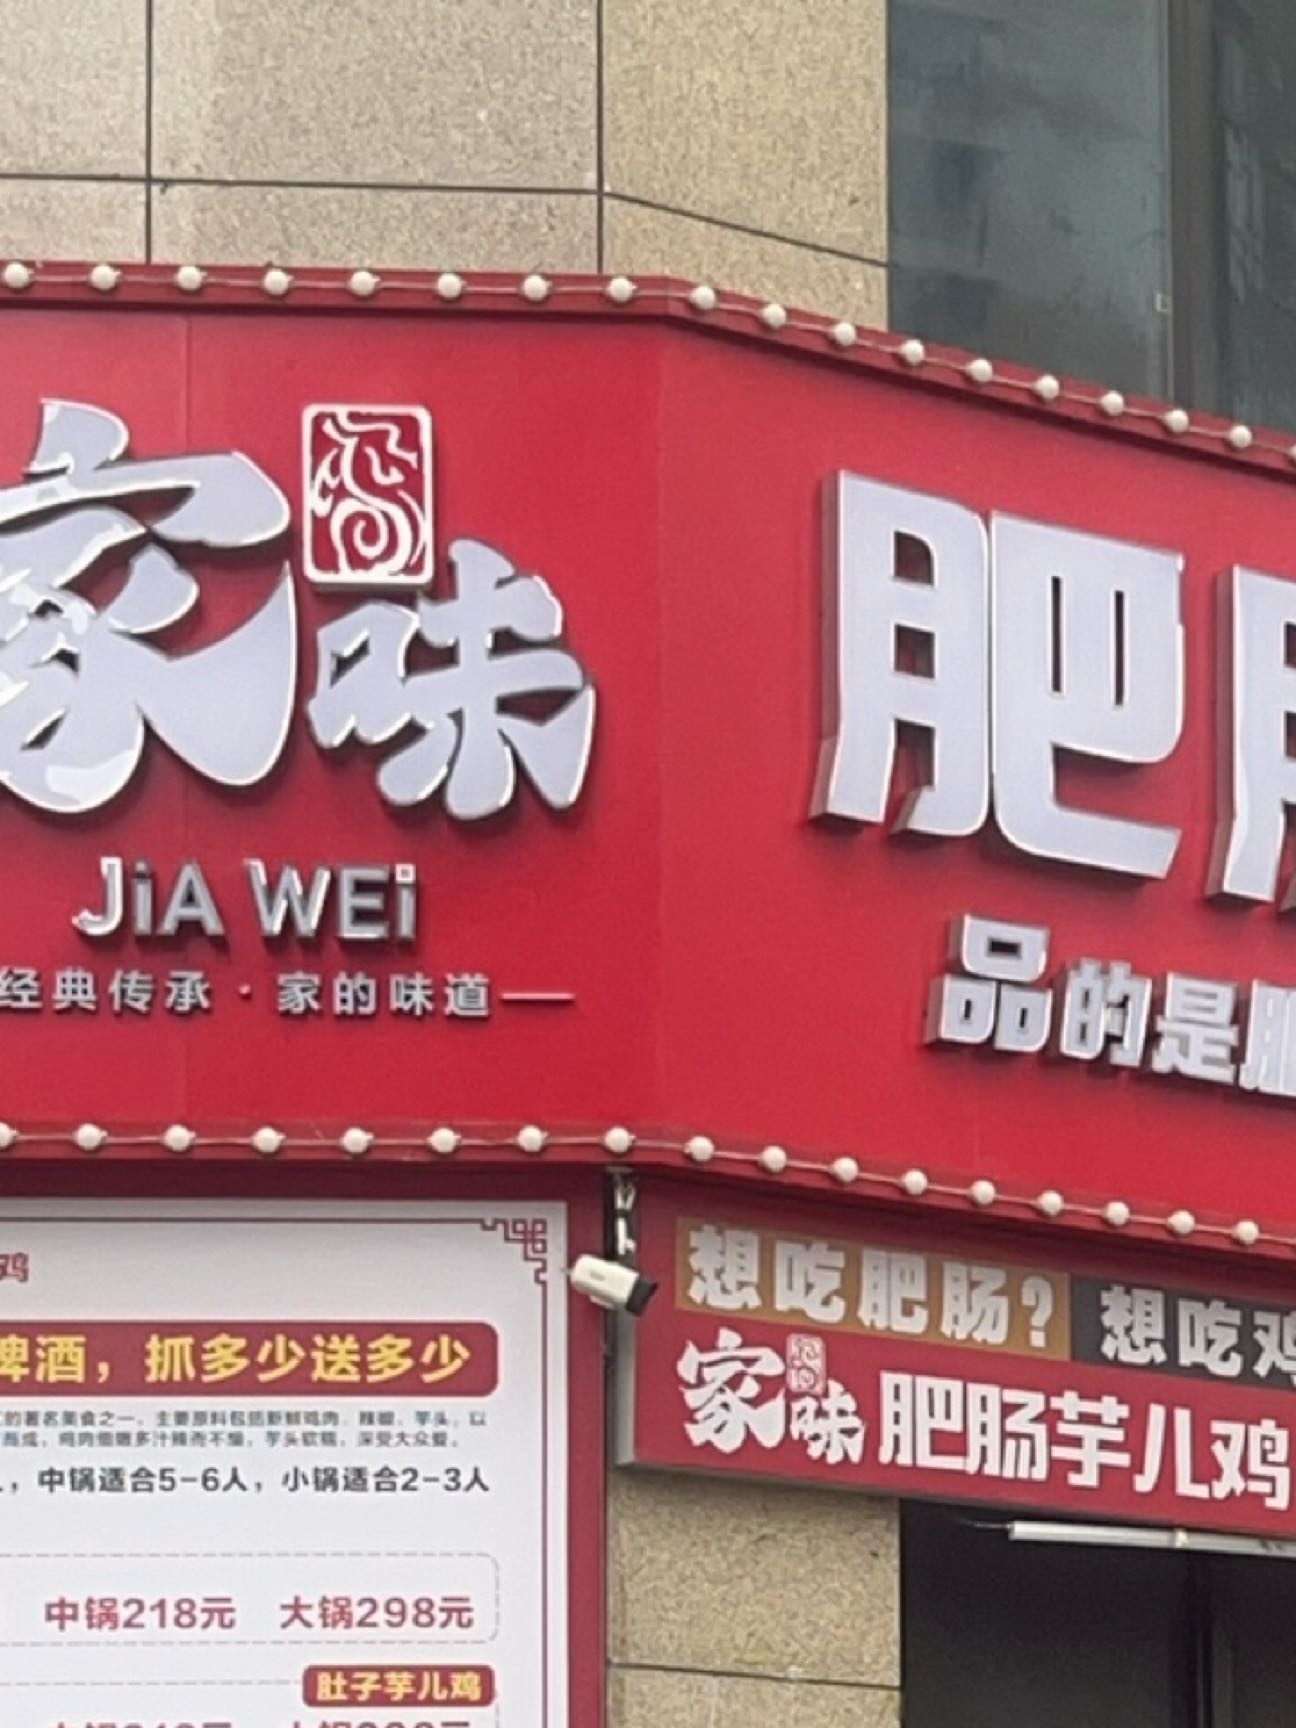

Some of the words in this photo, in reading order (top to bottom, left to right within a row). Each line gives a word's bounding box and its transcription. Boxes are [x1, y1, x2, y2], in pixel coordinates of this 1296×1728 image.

[688, 1224, 1053, 1348] 想吃肥肠？
[878, 1370, 1291, 1511] 肥肠芋儿鸡
[0, 1466, 490, 1494] ，中锅适合5-6人，小锅适合2-3人
[45, 1597, 236, 1631] 中锅218元
[280, 1595, 474, 1630] 大锅298元
[317, 1671, 482, 1702] 肚子芋儿鸡
